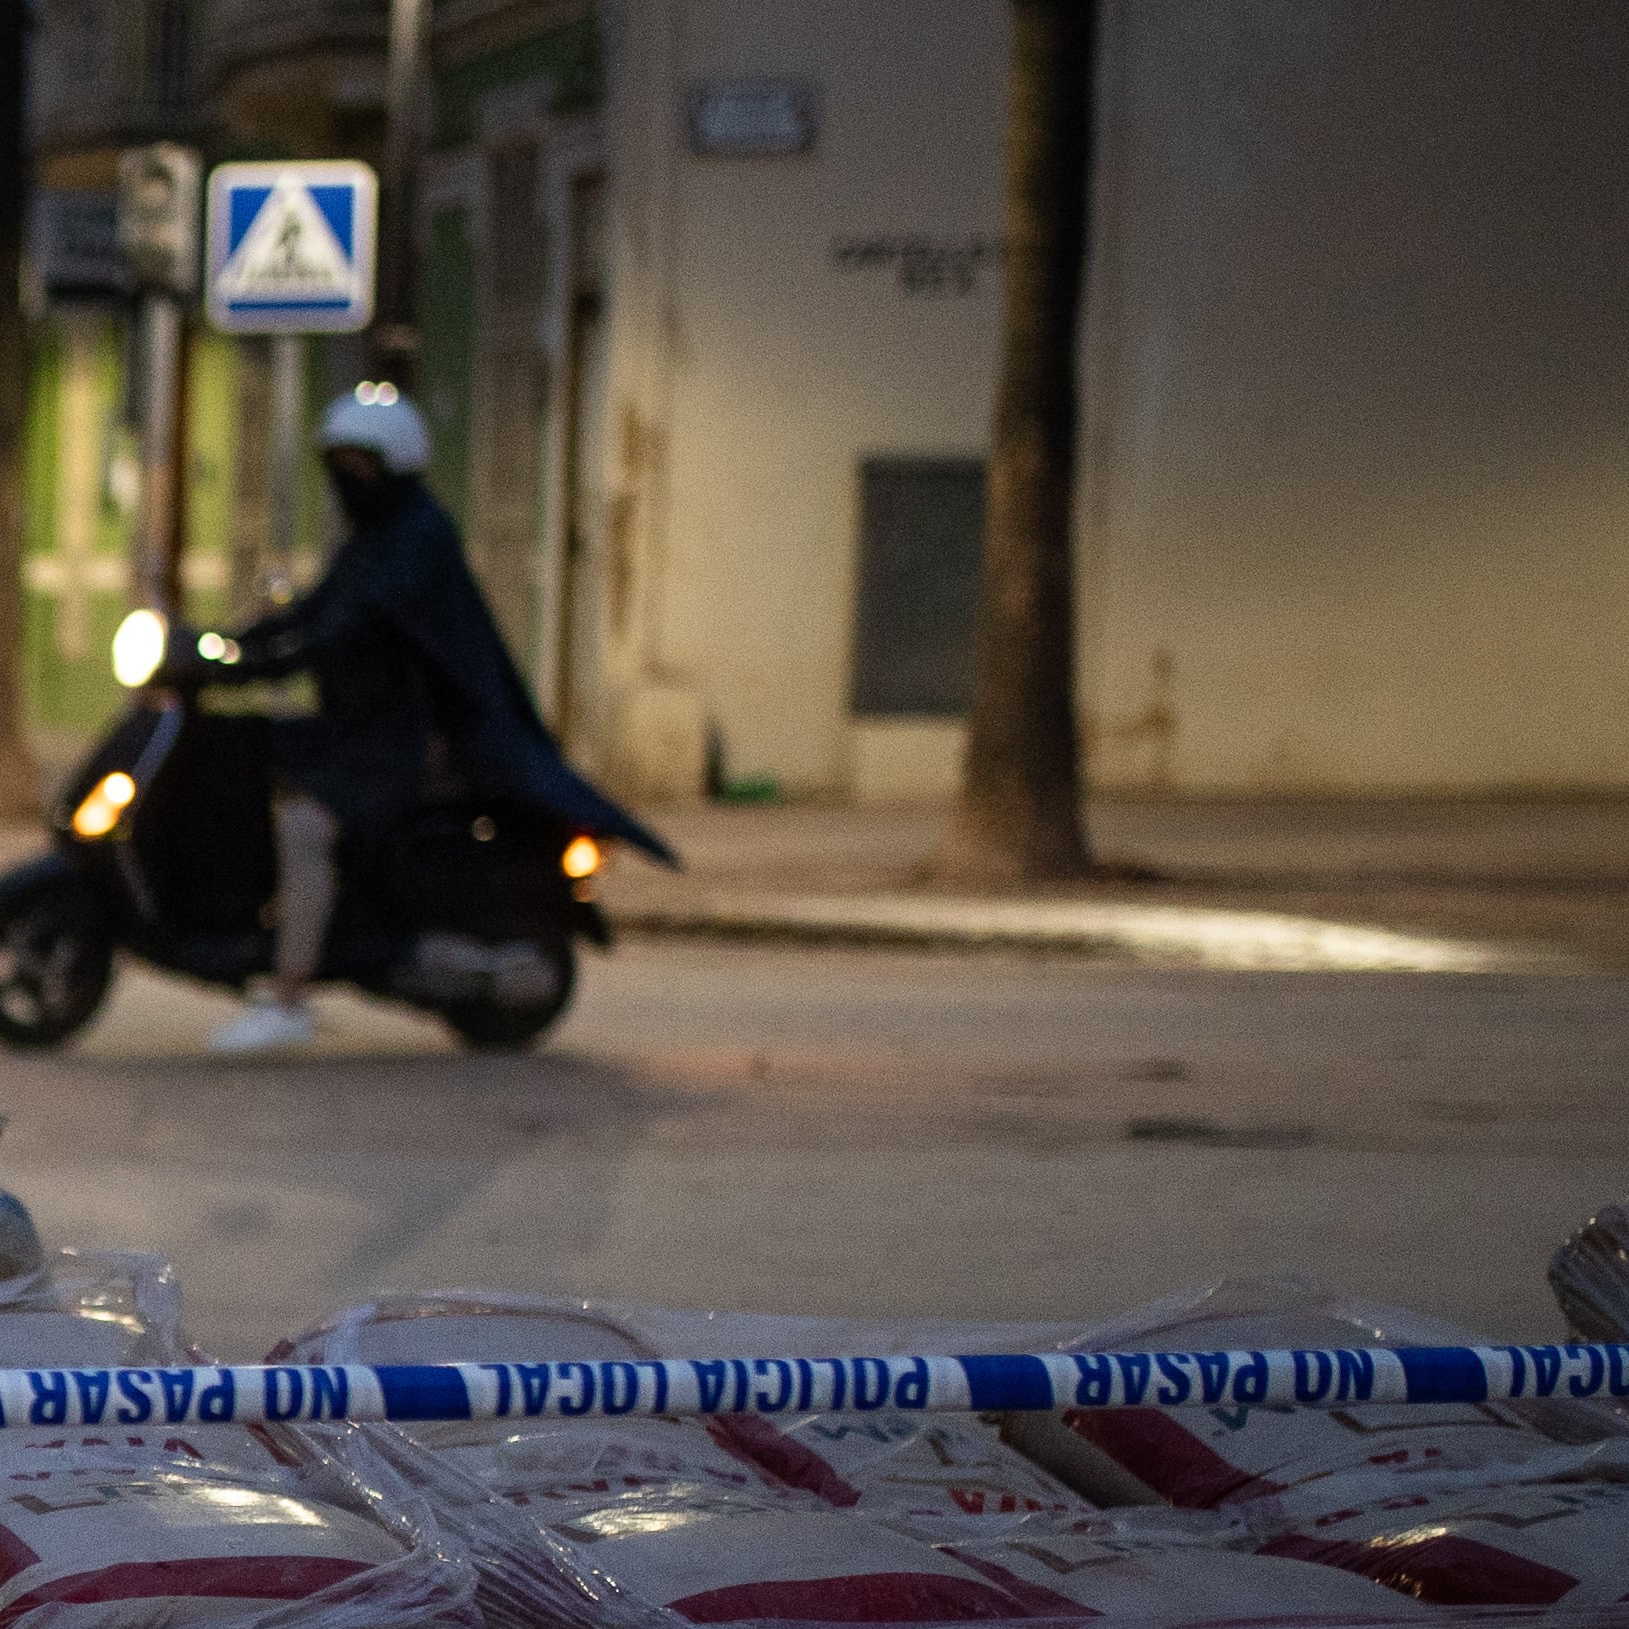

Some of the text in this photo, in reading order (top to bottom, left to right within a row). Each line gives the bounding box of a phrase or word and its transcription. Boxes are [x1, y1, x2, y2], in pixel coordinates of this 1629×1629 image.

[28, 1366, 349, 1424] NO PASAR
[480, 1356, 929, 1417] POLICIA LOCAL
[1073, 1348, 1375, 1406] NO PASAR
[1492, 1345, 1629, 1397] OCAL
